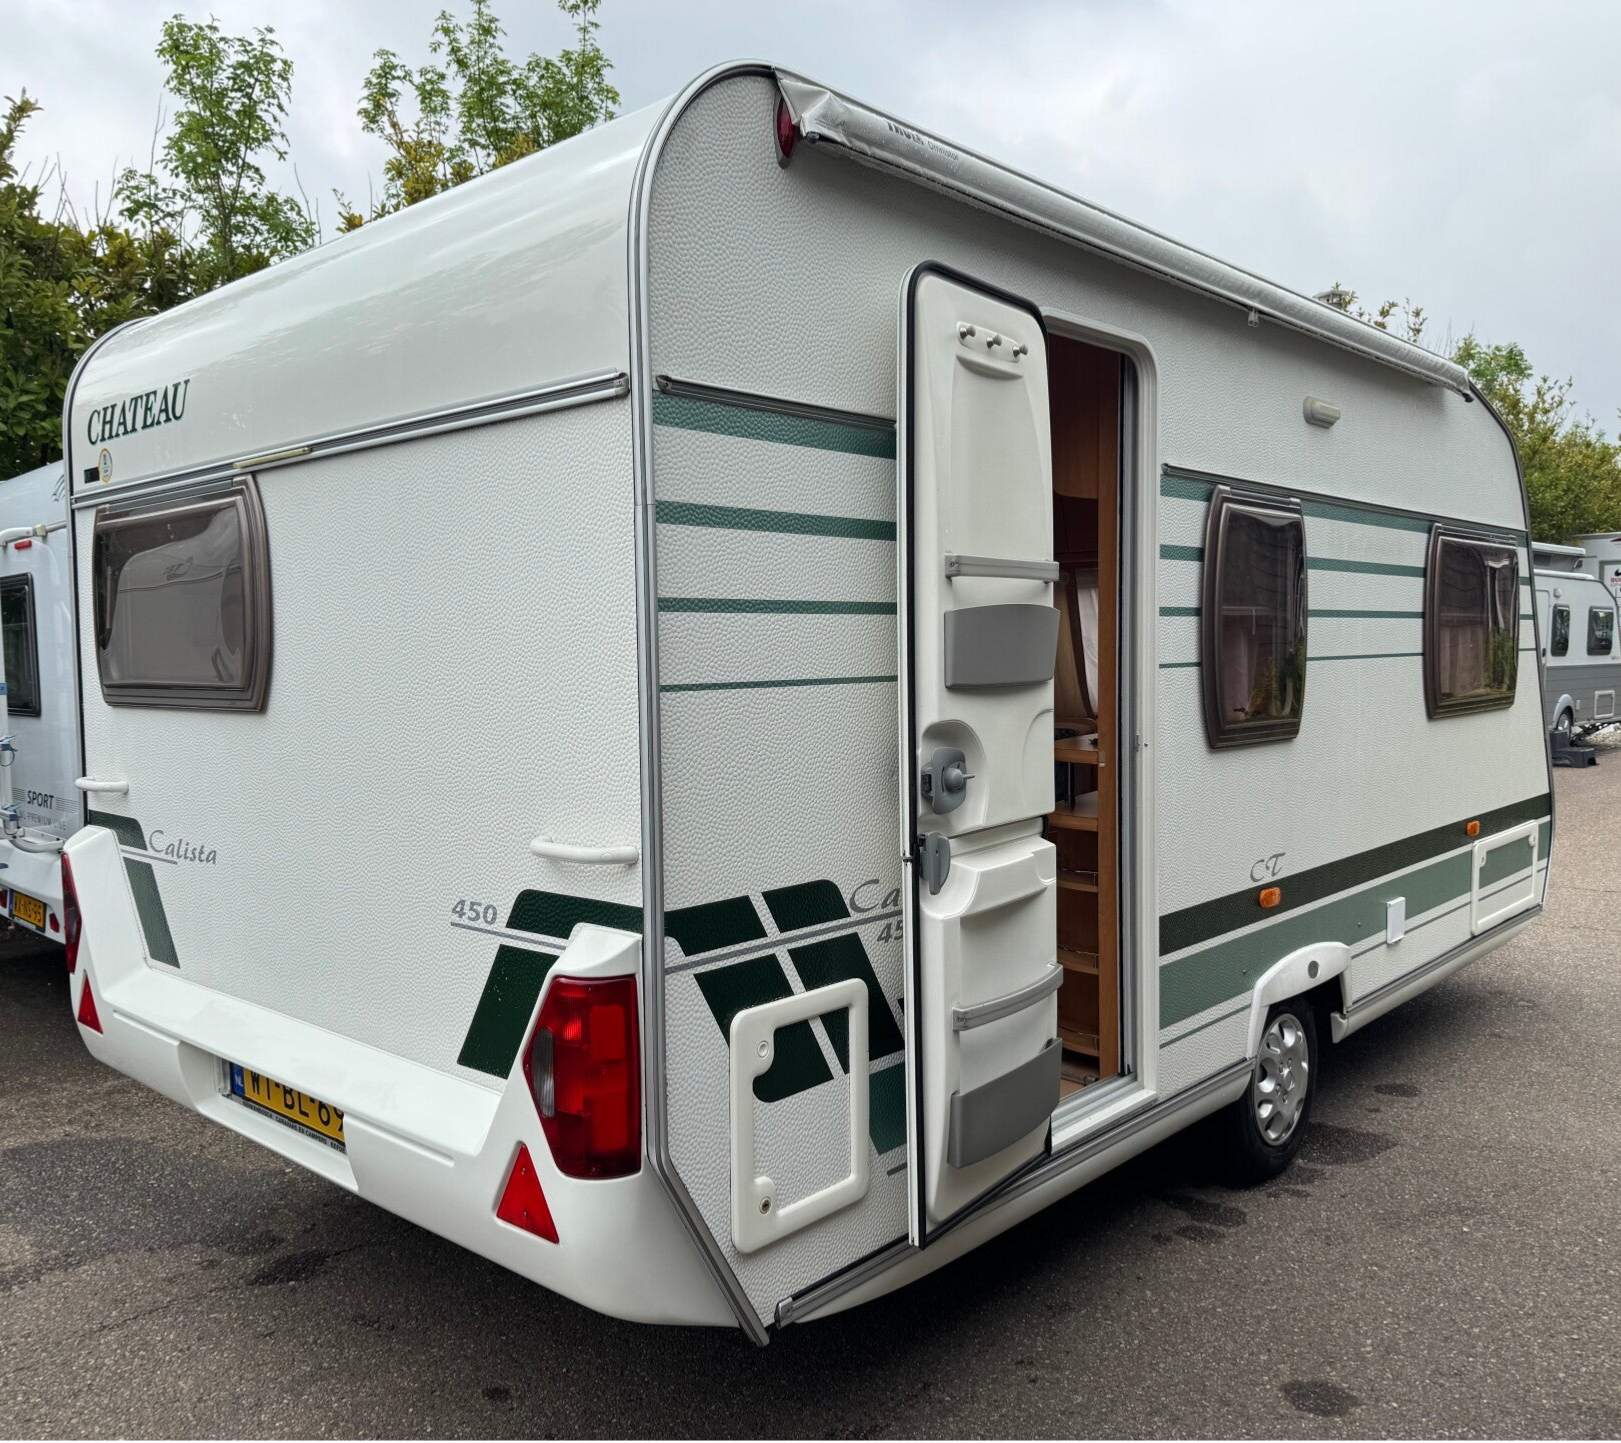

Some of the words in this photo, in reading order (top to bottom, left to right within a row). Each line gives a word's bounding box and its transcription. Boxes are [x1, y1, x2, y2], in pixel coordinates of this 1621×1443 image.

[87, 379, 190, 446] CHATEAU
[27, 790, 54, 809] SPORT
[149, 829, 217, 865] Calista
[451, 899, 498, 925] 450
[235, 1074, 244, 1088] NL
[305, 1130, 328, 1145] CAMPERS
